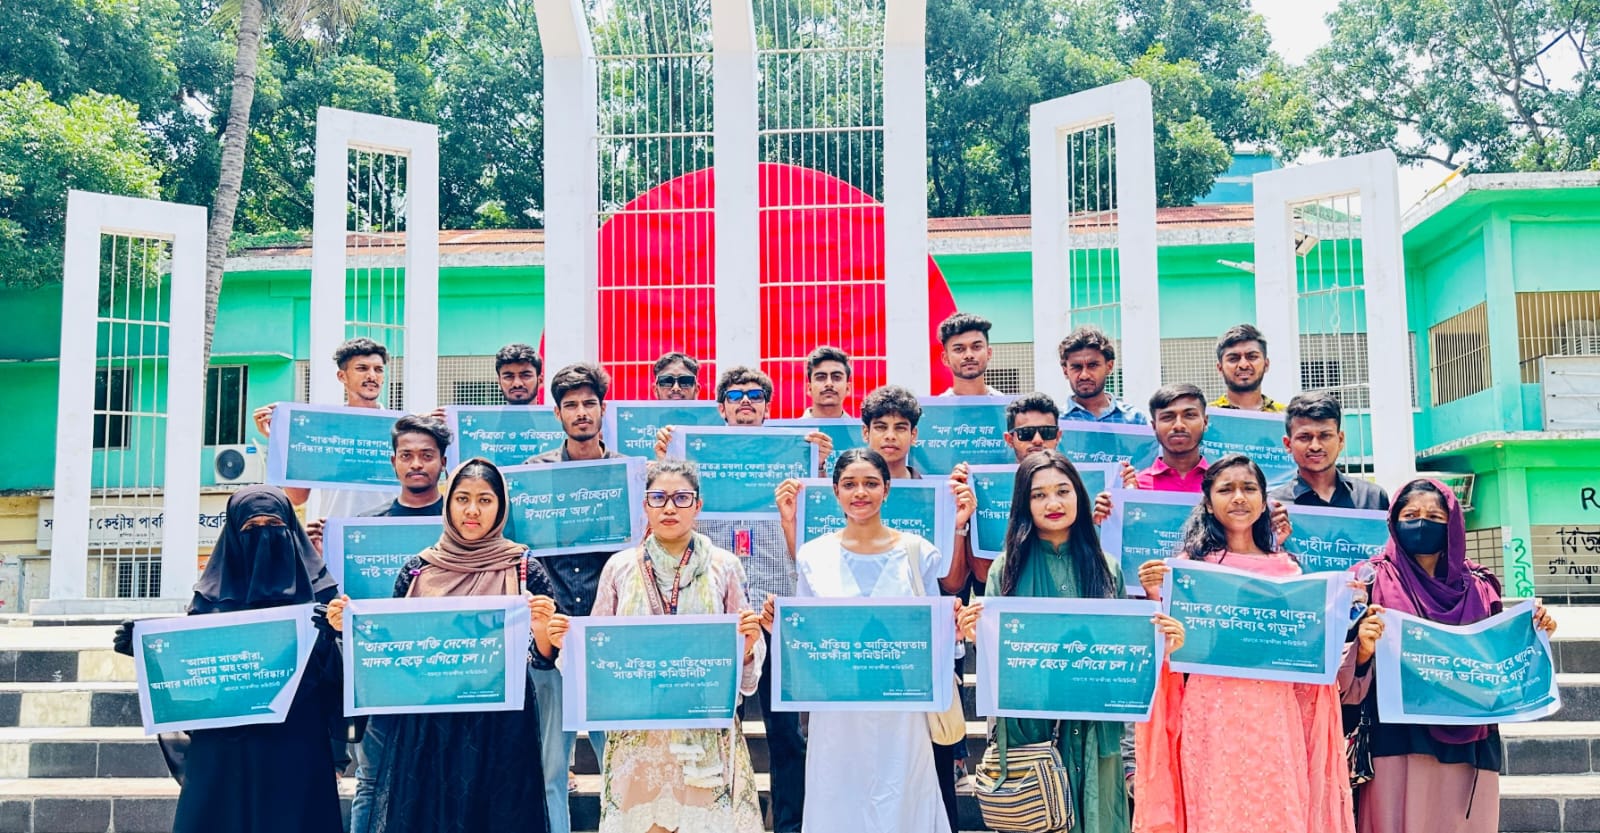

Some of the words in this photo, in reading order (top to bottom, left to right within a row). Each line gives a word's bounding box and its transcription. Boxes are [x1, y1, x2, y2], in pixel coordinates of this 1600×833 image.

[508, 431, 517, 440] ও
[631, 424, 658, 438] “শহী
[556, 492, 566, 502] ও
[1215, 604, 1250, 617] থেকে
[1253, 607, 1278, 620] দূরে
[1185, 615, 1216, 630] সুন্দর
[416, 636, 442, 650] শক্তি
[444, 637, 477, 650] দেশের
[854, 641, 861, 649] ও
[1062, 640, 1087, 653] শক্তি
[1090, 644, 1125, 656] দেশের
[808, 649, 850, 661] সাতক্ষীরা
[362, 656, 392, 668] মাদক
[659, 660, 667, 668] ও
[1007, 657, 1038, 669] মাদক
[613, 667, 656, 680] সাতক্ষীরা
[1416, 665, 1454, 682] সুন্দর
